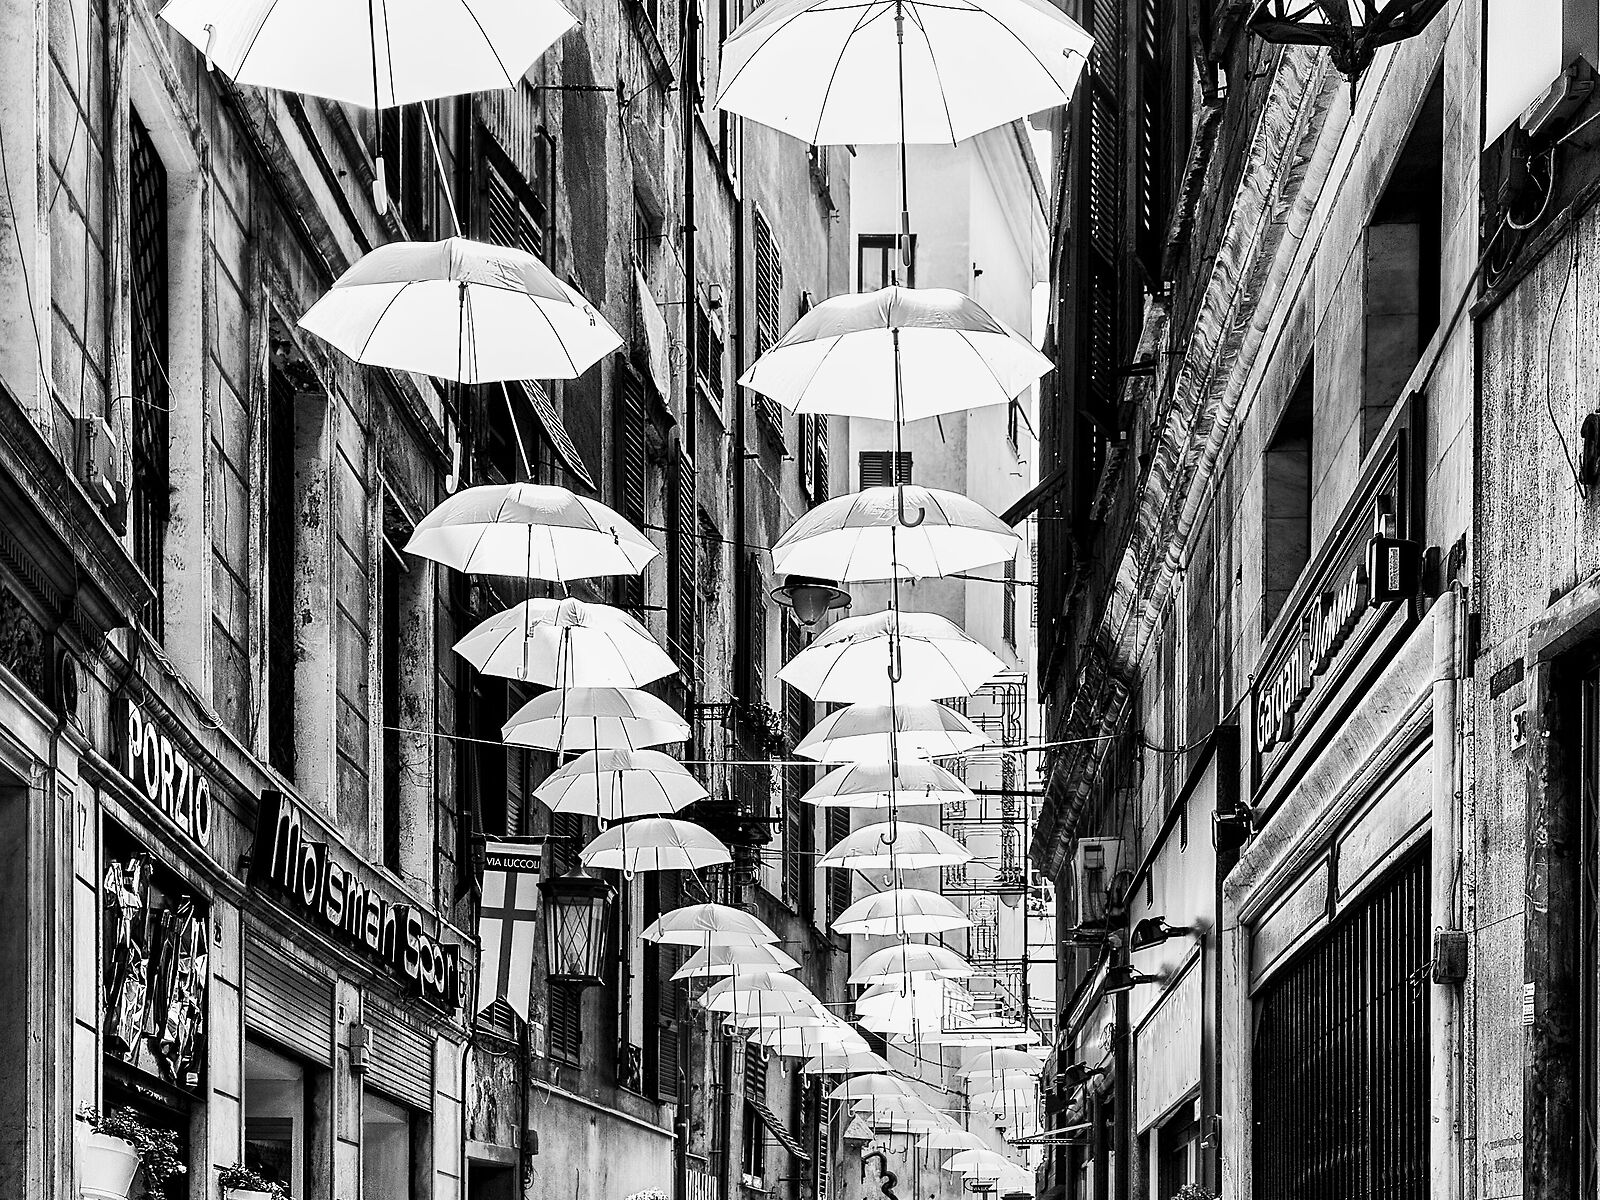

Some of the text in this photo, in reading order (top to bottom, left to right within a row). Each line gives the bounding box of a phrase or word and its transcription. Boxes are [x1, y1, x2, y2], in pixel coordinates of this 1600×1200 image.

[1257, 566, 1359, 753] Gargani Donna
[128, 698, 213, 848] PORZIO
[486, 857, 540, 869] VIA LUCCOLI
